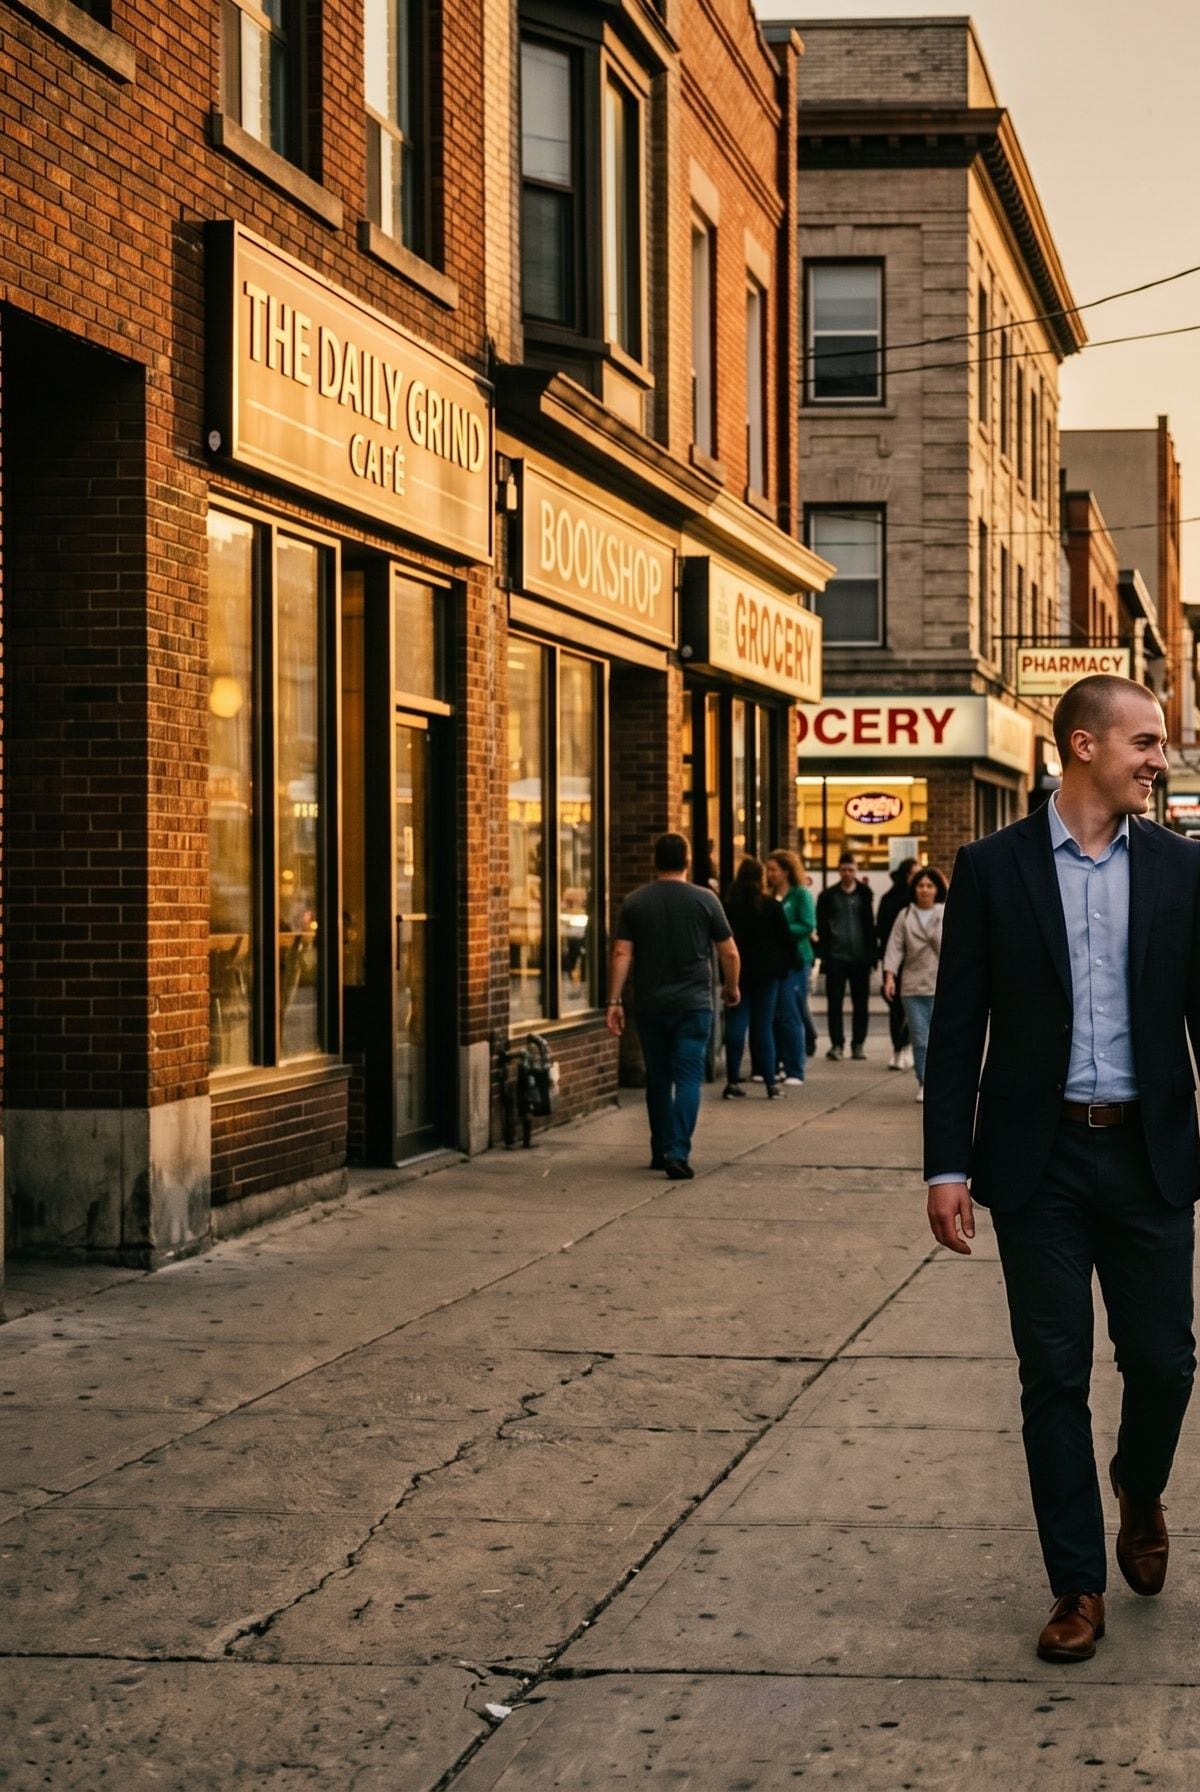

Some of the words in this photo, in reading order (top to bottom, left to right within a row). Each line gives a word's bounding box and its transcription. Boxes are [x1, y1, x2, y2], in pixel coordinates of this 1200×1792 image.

[243, 280, 312, 387] THE
[318, 325, 403, 432] DAILY
[406, 378, 485, 474] GRIND
[349, 432, 406, 496] CAFÉ
[540, 499, 662, 618] BOOKSHOP
[735, 592, 814, 686] GROCERY
[1022, 655, 1124, 673] PHARMACY
